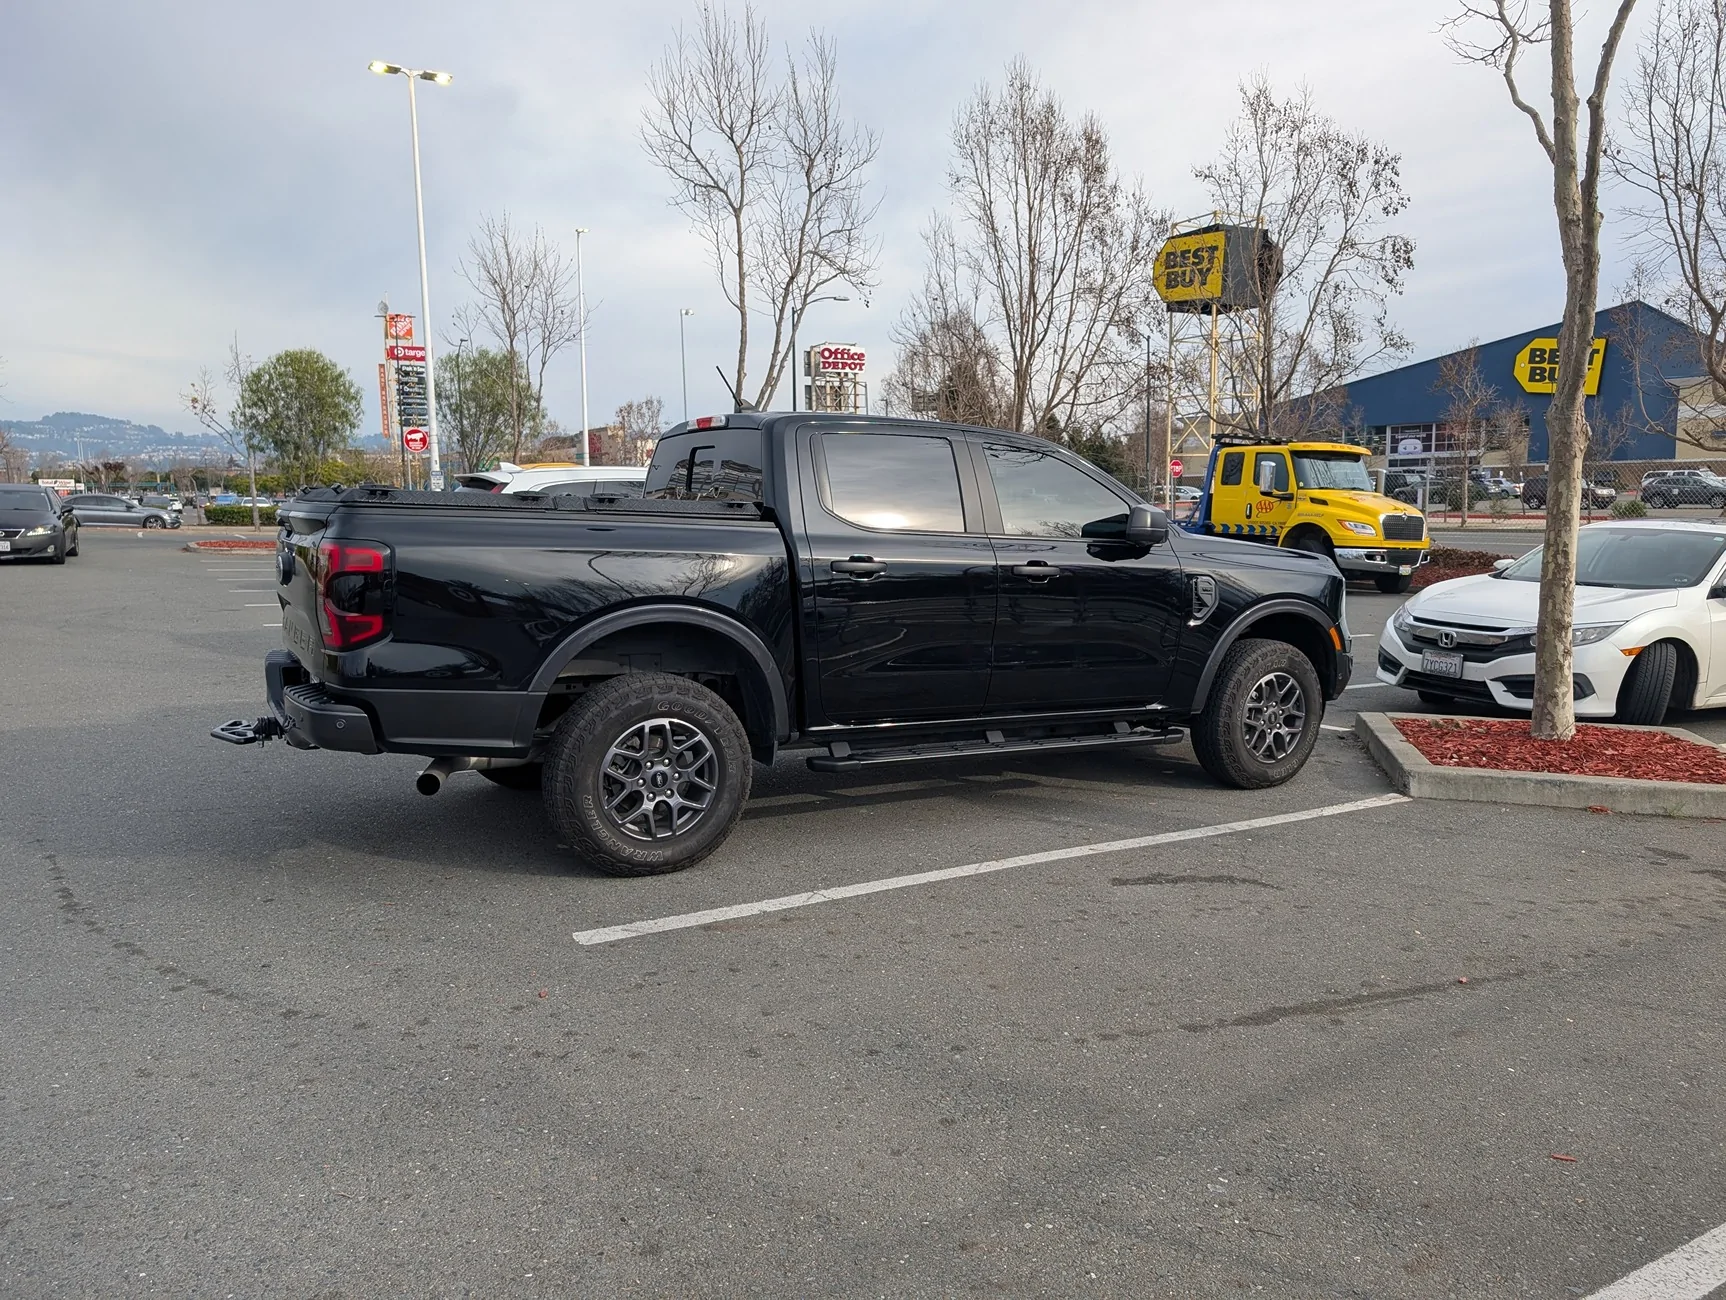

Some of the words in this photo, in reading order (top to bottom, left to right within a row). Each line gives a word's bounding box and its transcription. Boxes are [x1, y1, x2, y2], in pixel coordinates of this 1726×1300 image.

[1164, 245, 1219, 270] BEST
[1165, 266, 1212, 290] BUY
[405, 348, 425, 357] targe
[820, 347, 866, 361] Office
[1528, 347, 1600, 365] BET
[821, 361, 866, 371] DEPOT
[1528, 366, 1595, 383] BU
[1256, 500, 1274, 513] AAA
[583, 794, 664, 862] WRANGLER
